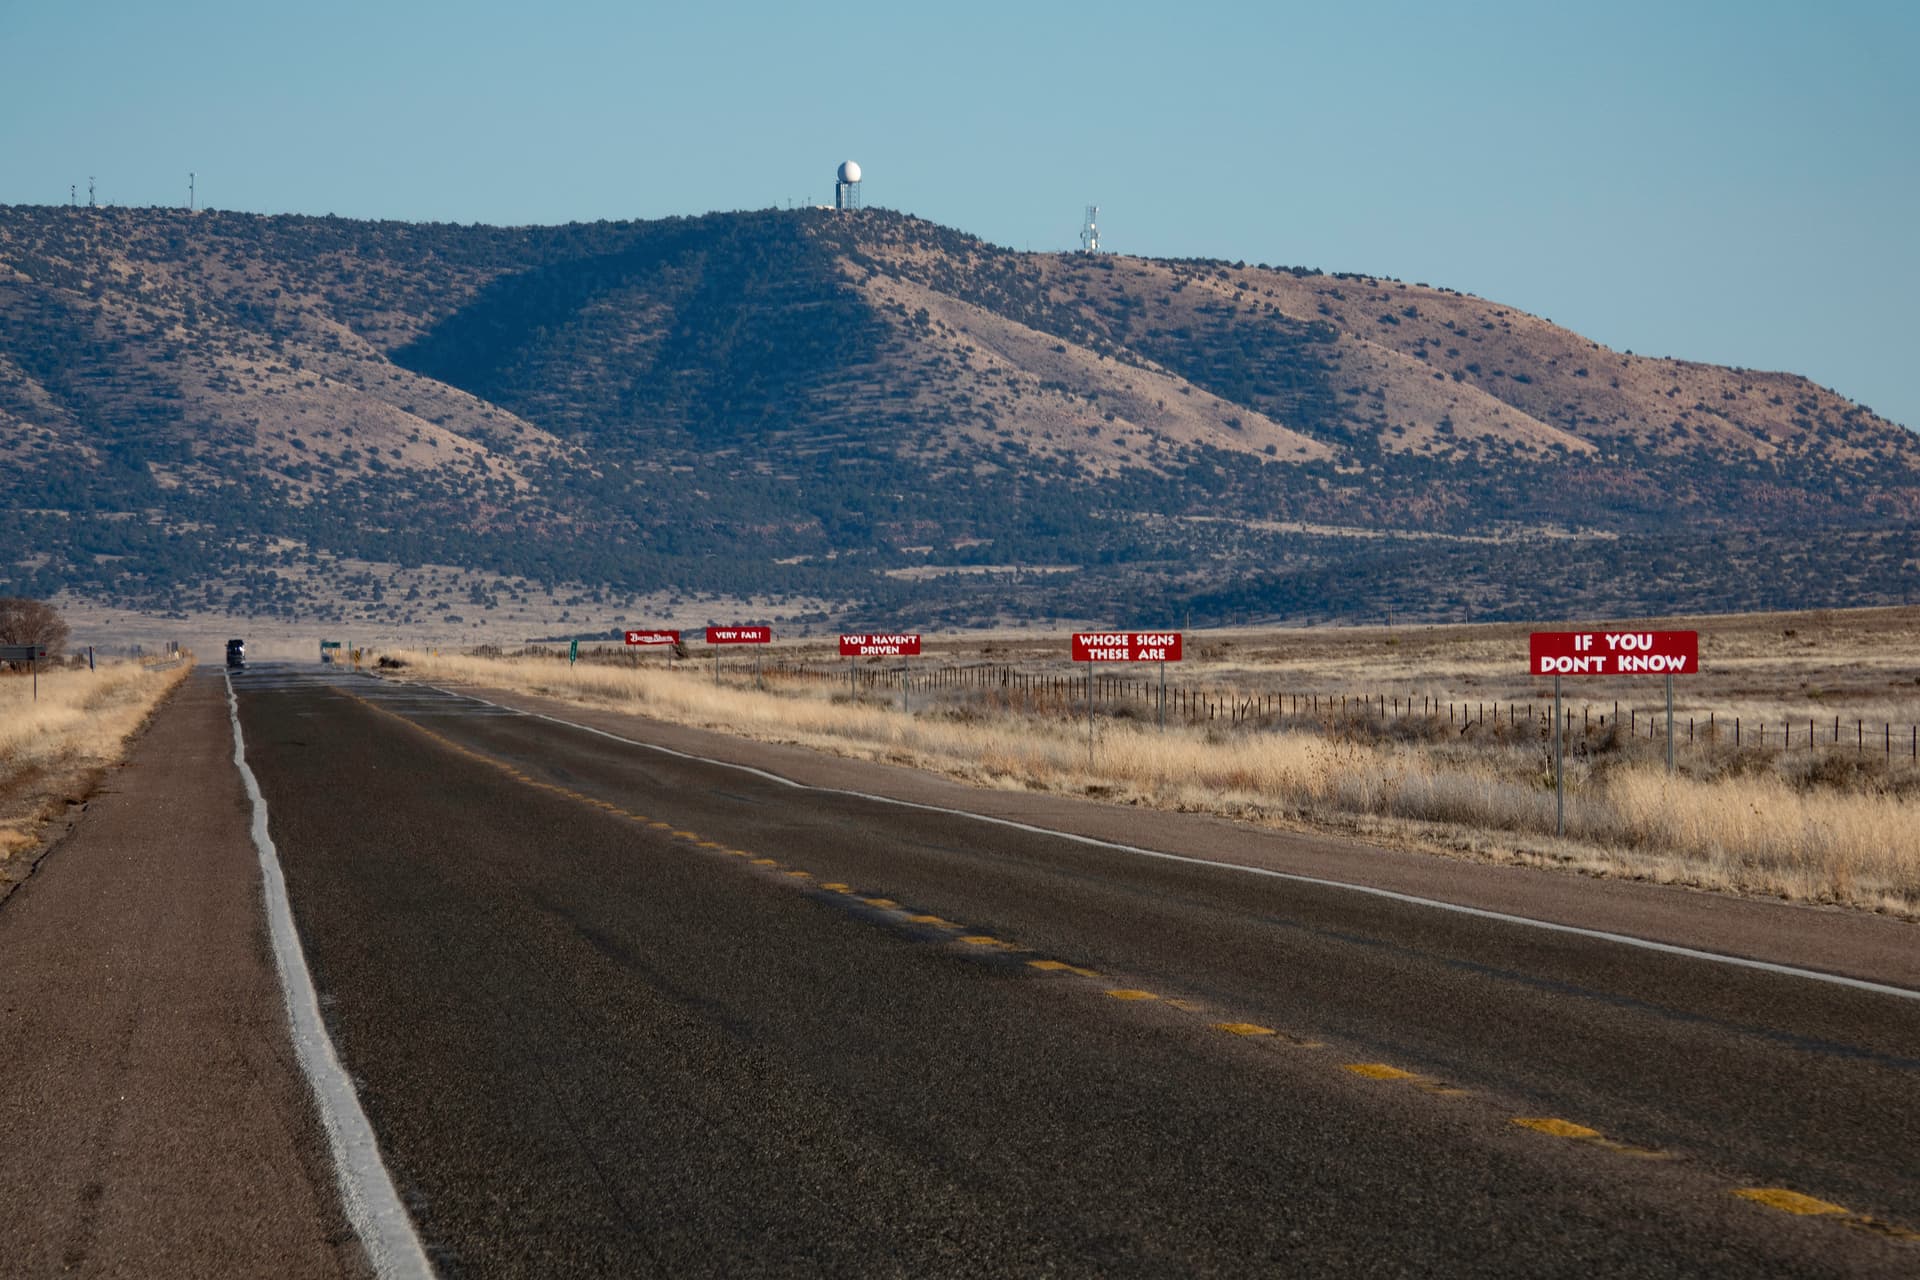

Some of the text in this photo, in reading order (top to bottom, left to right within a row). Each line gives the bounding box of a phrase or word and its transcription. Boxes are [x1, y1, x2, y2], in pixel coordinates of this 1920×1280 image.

[715, 631, 737, 639] VERY
[843, 635, 866, 645] YOU
[1080, 635, 1175, 646] WHOSE SIGNS
[1575, 633, 1653, 651] IF YOU
[860, 645, 900, 655] DRIVEN
[1088, 648, 1165, 660] THESE ARE
[1540, 655, 1687, 673] DON'T KNOW
